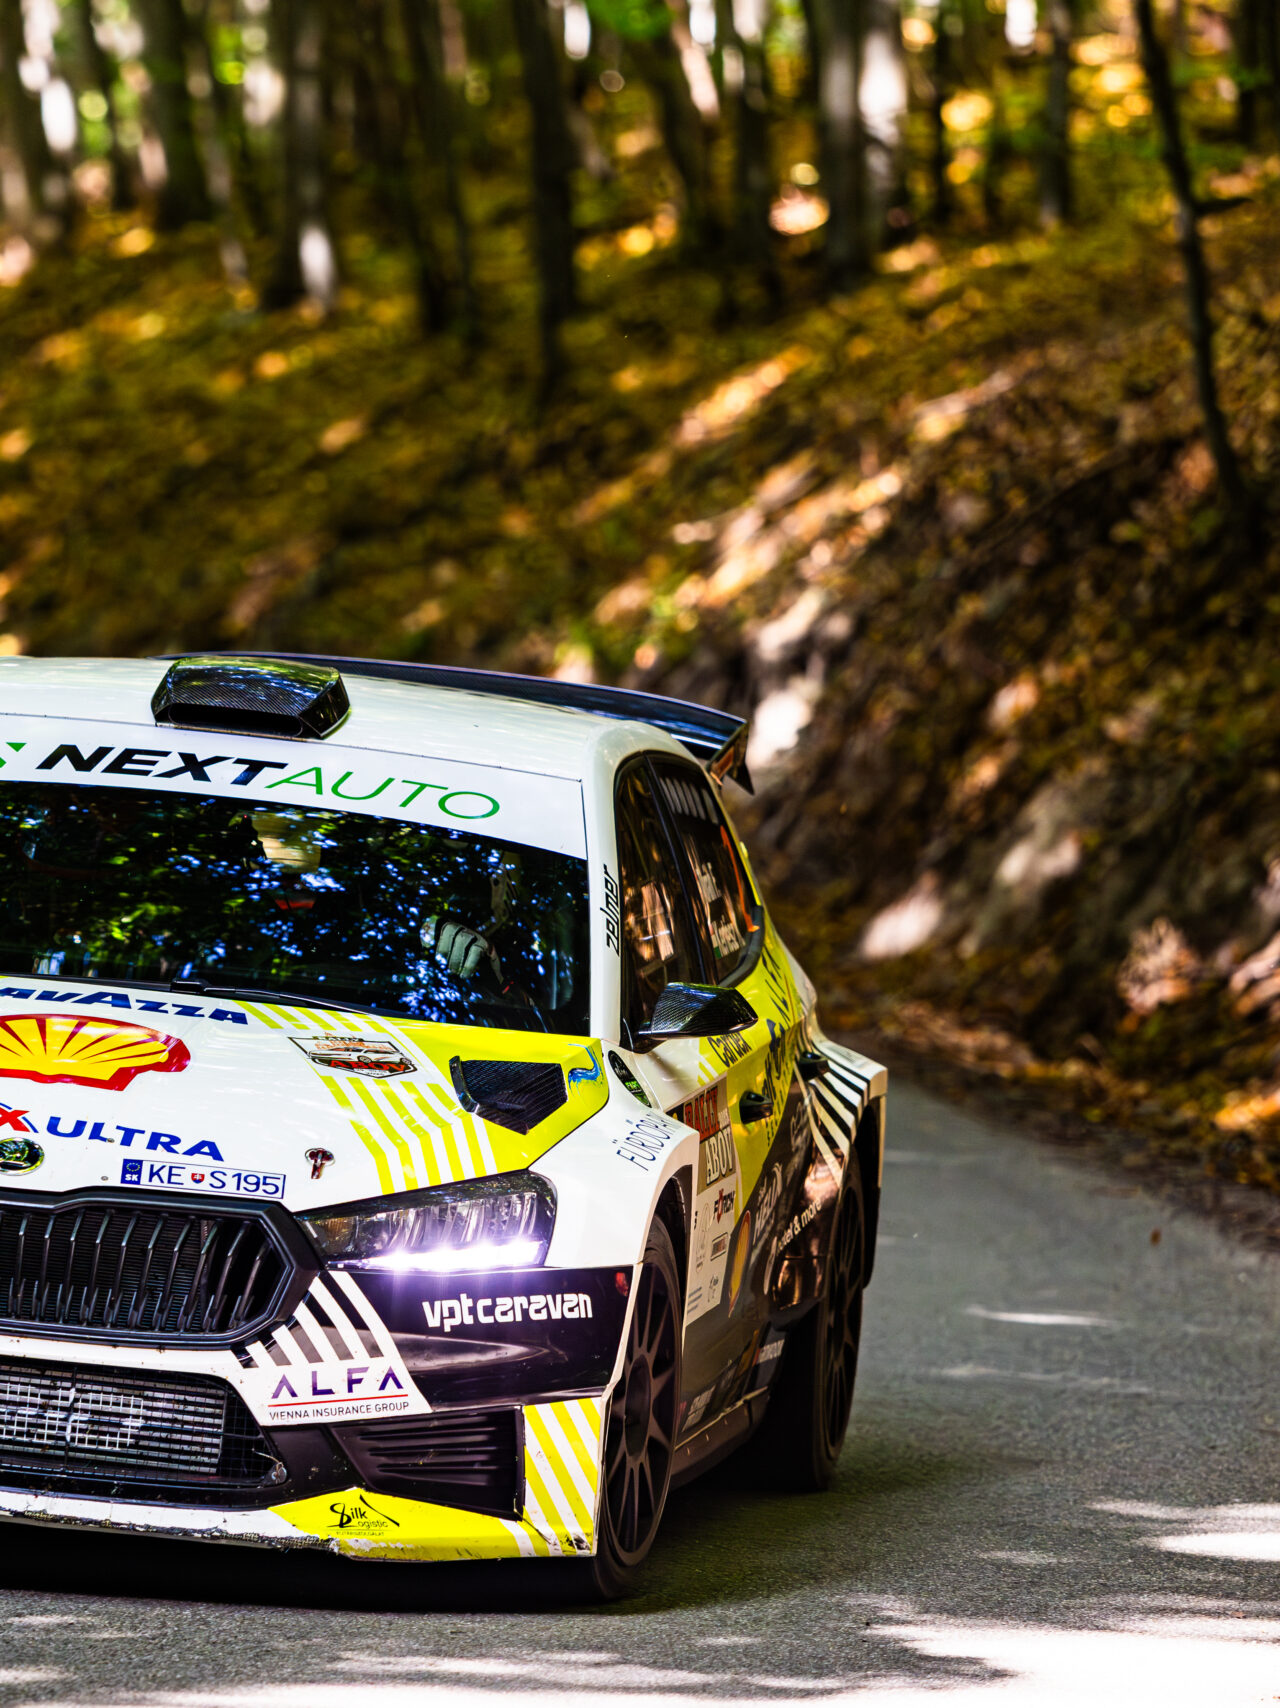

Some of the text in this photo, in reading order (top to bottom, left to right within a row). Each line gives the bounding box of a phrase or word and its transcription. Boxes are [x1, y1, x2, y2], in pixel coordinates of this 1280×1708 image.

[599, 863, 620, 957] zelmer
[46, 1115, 225, 1162] ULTRA
[705, 1124, 733, 1186] ABOV
[125, 1173, 139, 1182] SK
[148, 1163, 187, 1186] KE
[271, 1366, 405, 1400] ALFA
[269, 1401, 410, 1422] VIENNA INSURANCE GROUP
[328, 1502, 369, 1529] Silk
